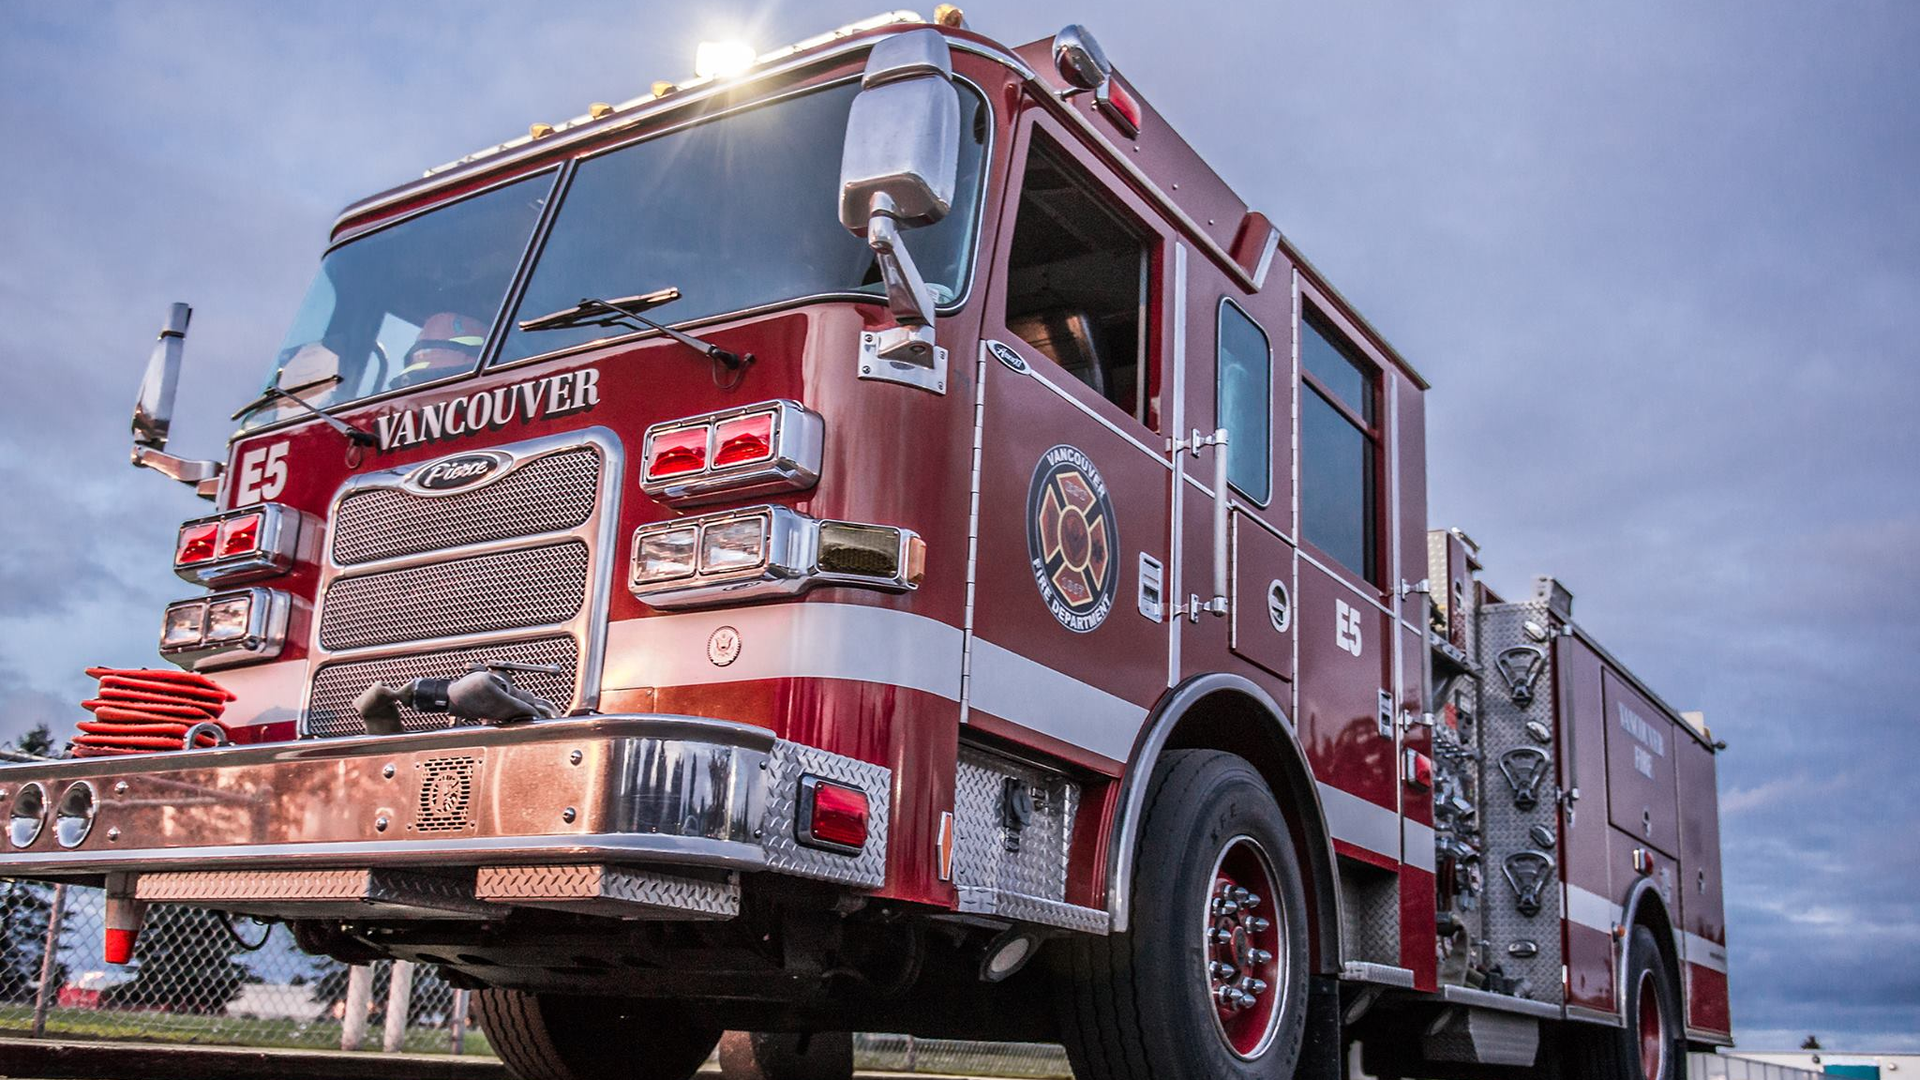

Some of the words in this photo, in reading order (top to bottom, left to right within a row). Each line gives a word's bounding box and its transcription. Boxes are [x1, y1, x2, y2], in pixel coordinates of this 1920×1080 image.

[377, 367, 600, 451] VANCOUVER
[236, 441, 290, 507] E5
[423, 460, 488, 487] Pierce
[1046, 447, 1106, 499] VANCOUVER
[1032, 557, 1053, 602] FIRE
[1051, 592, 1111, 630] DEPARTMENT
[1335, 598, 1362, 657] E5
